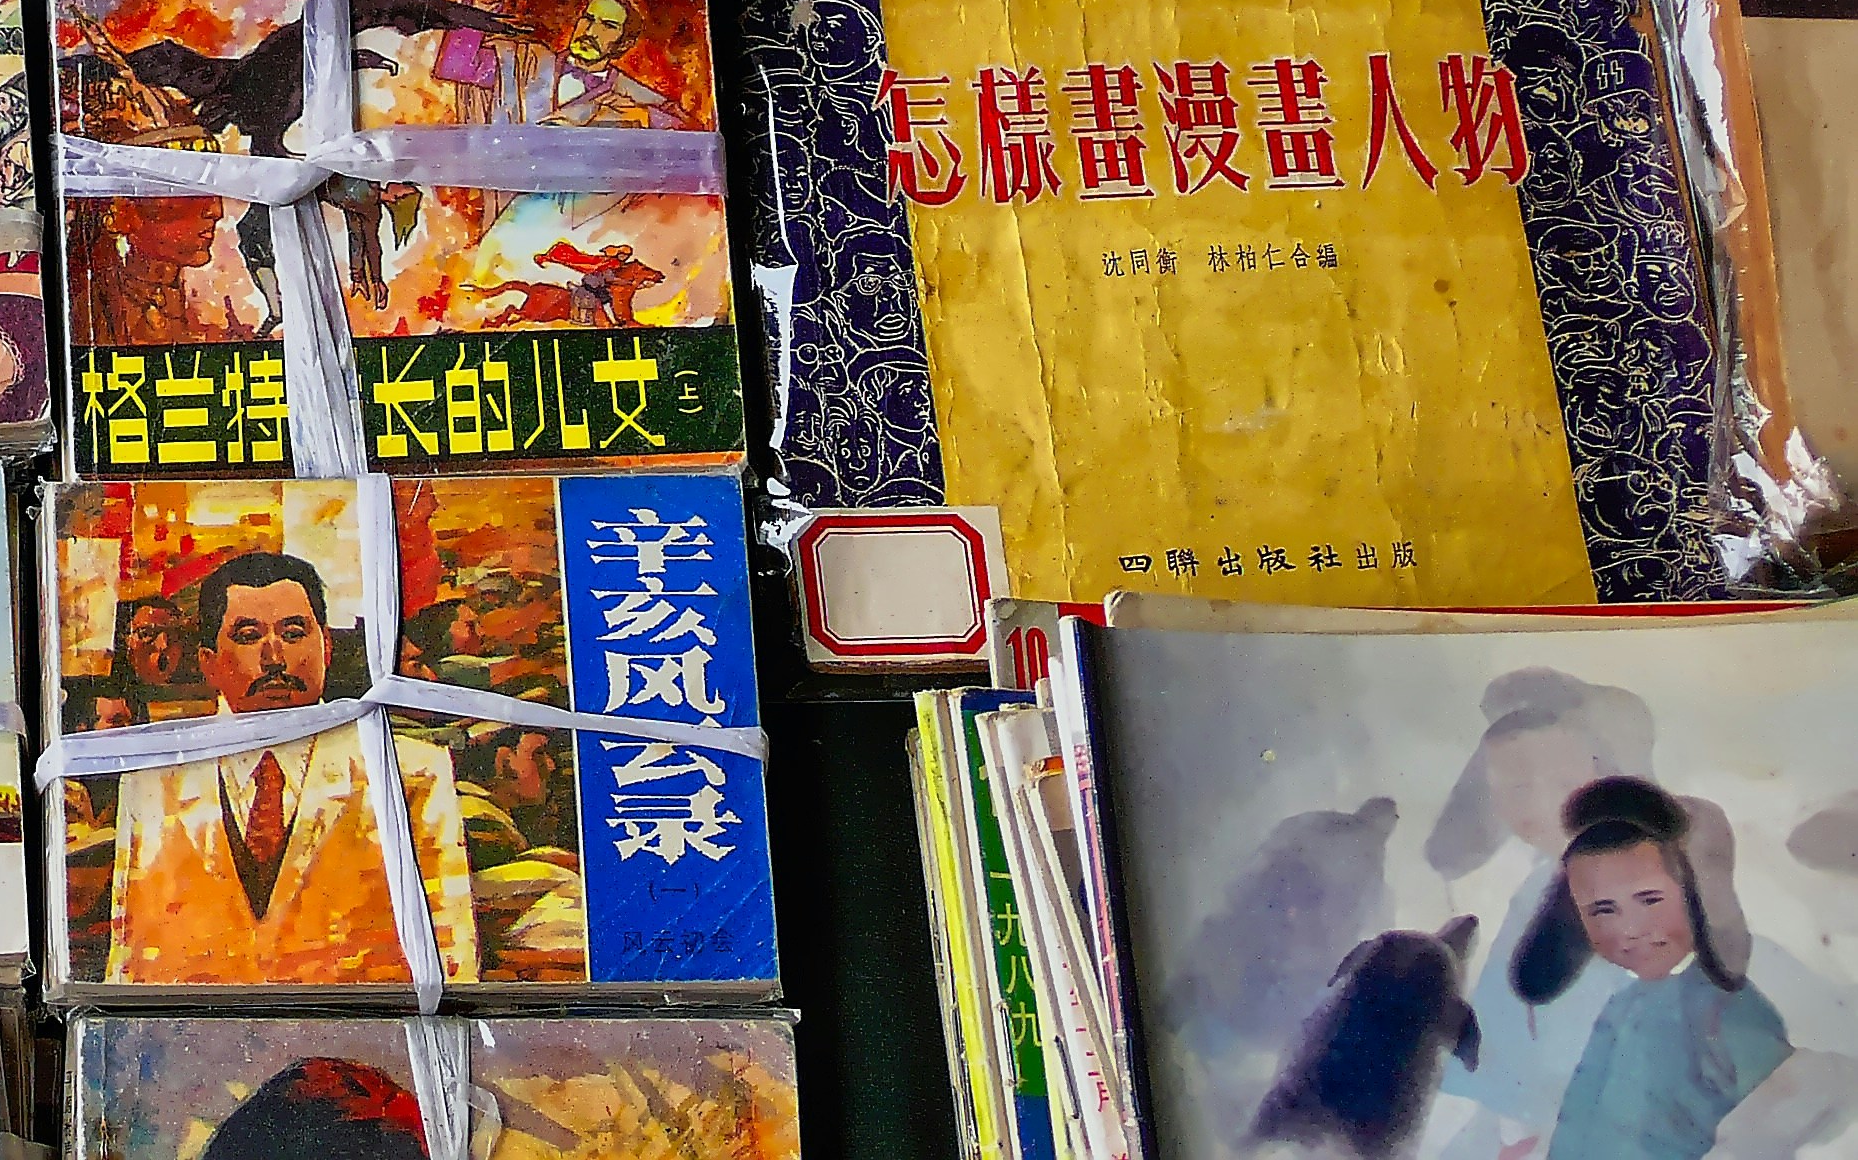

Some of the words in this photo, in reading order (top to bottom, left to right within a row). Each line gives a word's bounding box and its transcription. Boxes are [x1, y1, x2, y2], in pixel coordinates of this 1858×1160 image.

[873, 53, 1530, 207] 怎樣畫漫畫人物
[1102, 246, 1178, 279] 沈同衡
[1208, 242, 1339, 271] 林柏仁合編
[82, 336, 665, 464] 格兰特长的儿女
[1118, 541, 1419, 577] 四聯出版社出版
[587, 508, 742, 866] 辛亥风云录
